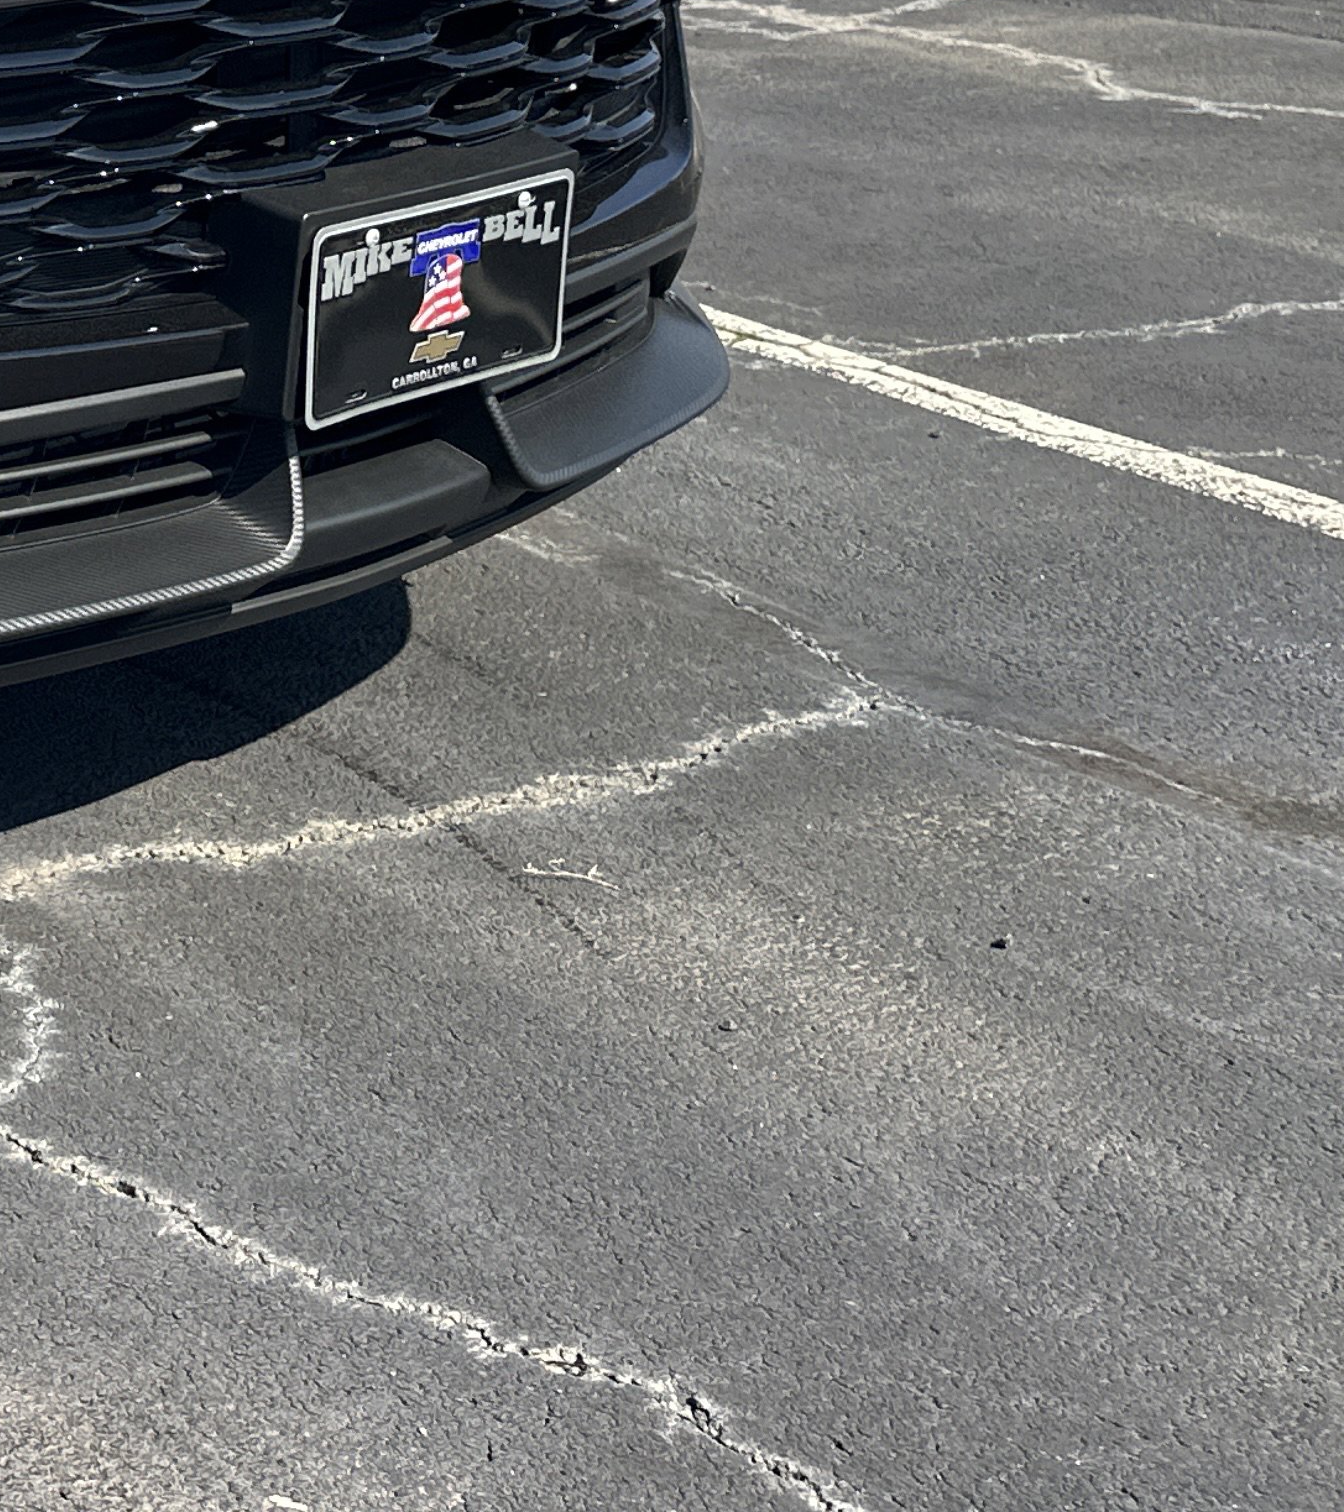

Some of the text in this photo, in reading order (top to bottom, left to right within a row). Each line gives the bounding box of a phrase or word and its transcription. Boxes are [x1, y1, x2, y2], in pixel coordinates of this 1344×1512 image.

[320, 200, 561, 302] MIKE BELL
[417, 229, 479, 255] CHEVROLET
[391, 356, 478, 390] CARROLLTON, GA
